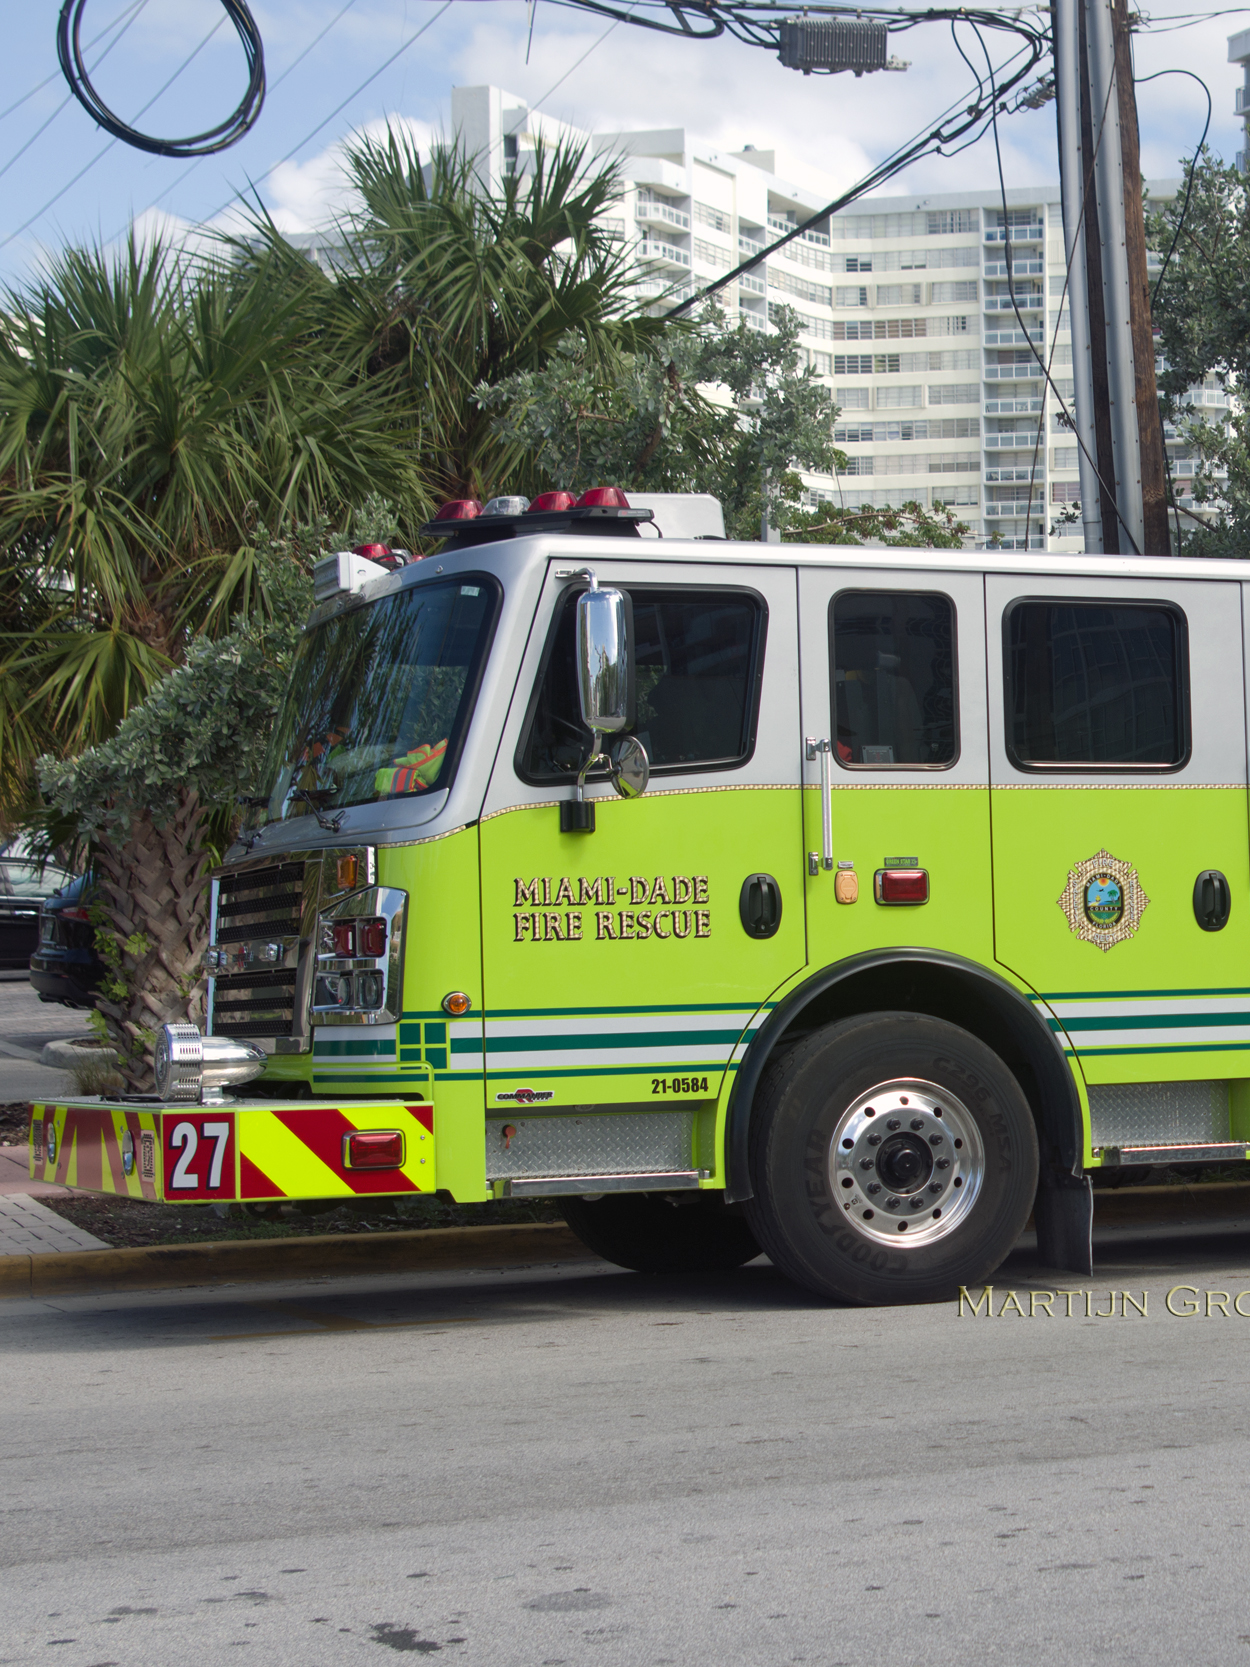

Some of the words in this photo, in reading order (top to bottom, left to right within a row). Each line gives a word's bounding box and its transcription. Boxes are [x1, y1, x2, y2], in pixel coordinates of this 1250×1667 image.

[1092, 858, 1114, 867] FIRE
[513, 876, 710, 907] MIAMI-DADE
[1086, 874, 1122, 888] MIAMI-DADE
[513, 911, 583, 942] FIRE
[595, 910, 711, 940] RESCUE
[651, 1077, 709, 1094] 21-0584
[932, 1057, 992, 1103] G296
[168, 1121, 230, 1190] 27
